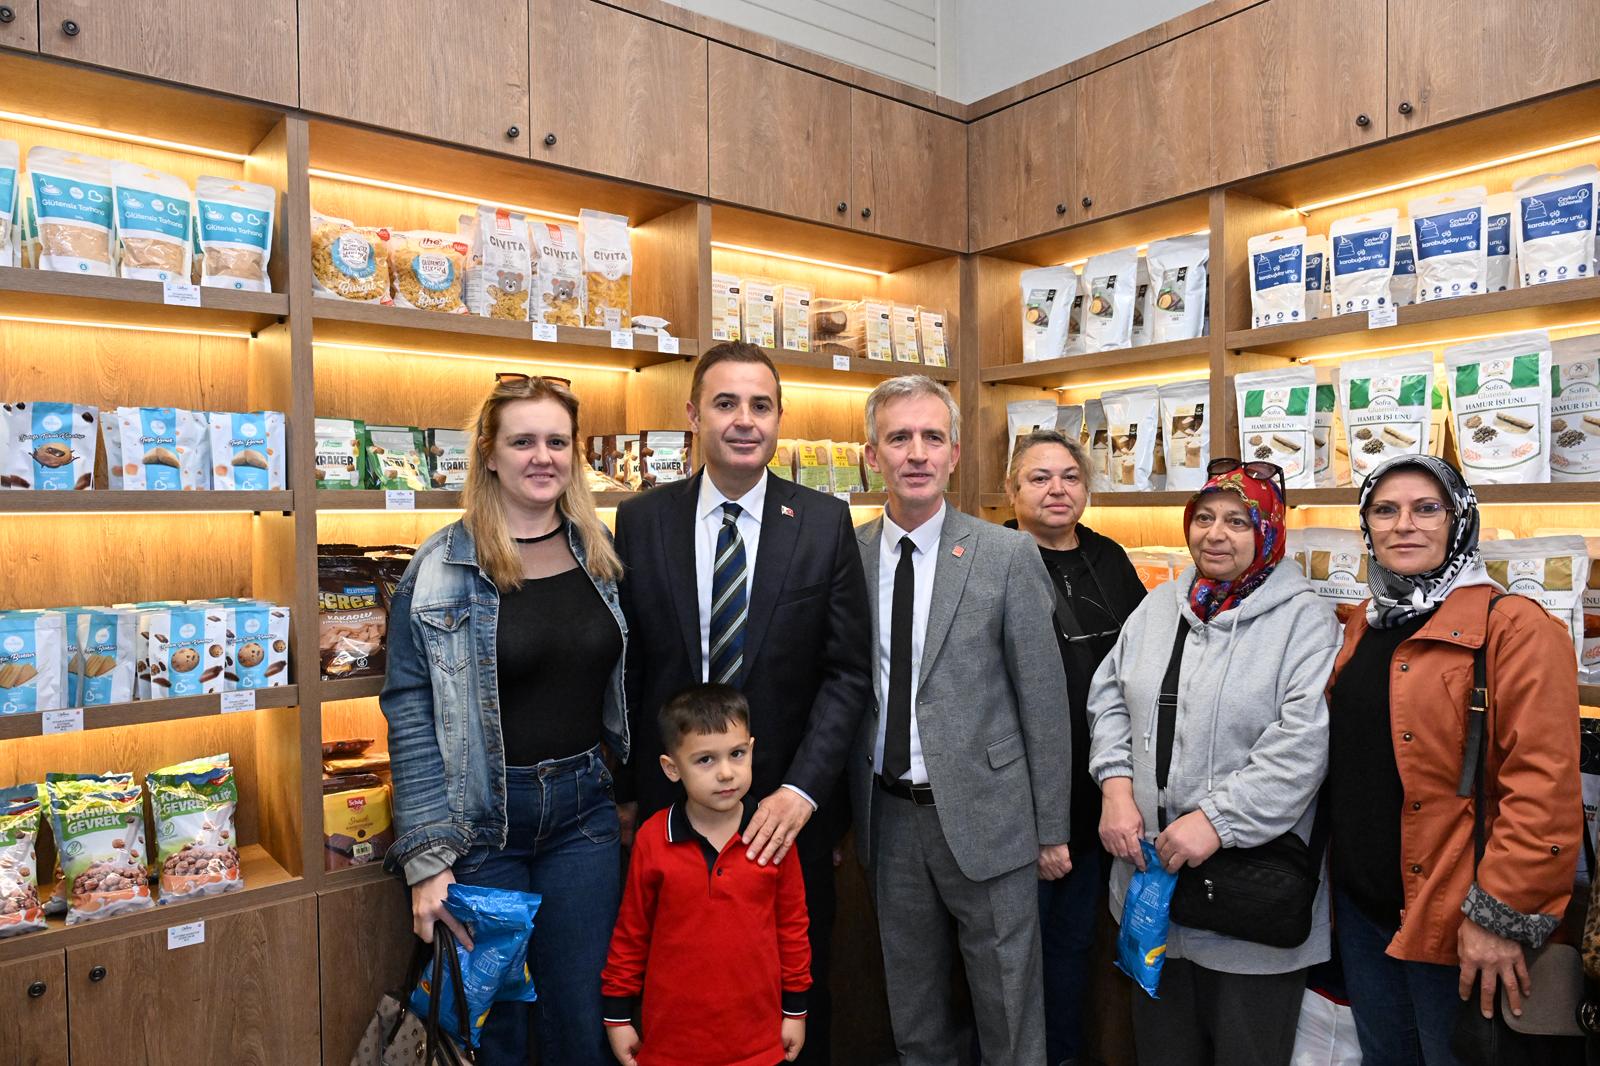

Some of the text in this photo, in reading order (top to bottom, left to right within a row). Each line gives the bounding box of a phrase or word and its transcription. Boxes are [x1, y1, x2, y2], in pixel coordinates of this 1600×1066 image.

[1528, 216, 1569, 229] karabuğday
[489, 235, 526, 252] CIVITA
[1422, 236, 1460, 248] karabuğday
[543, 246, 578, 260] CIVITA
[593, 250, 628, 261] CIVITA
[1339, 256, 1371, 266] karabuğday
[1485, 384, 1504, 392] Sofra
[1569, 387, 1590, 395] Sofra
[1465, 401, 1494, 411] HAMUR
[1507, 396, 1527, 404] UNU
[1357, 414, 1382, 423] HAMUR
[1395, 413, 1412, 421] UNU
[315, 455, 354, 466] KRAKER
[440, 461, 470, 471] KRAKE
[650, 461, 681, 471] KRAKER
[1320, 587, 1365, 597] EKMEK UNU
[1515, 583, 1535, 591] Sofra
[163, 800, 209, 814] GEVREK
[67, 814, 121, 835] GEVREK
